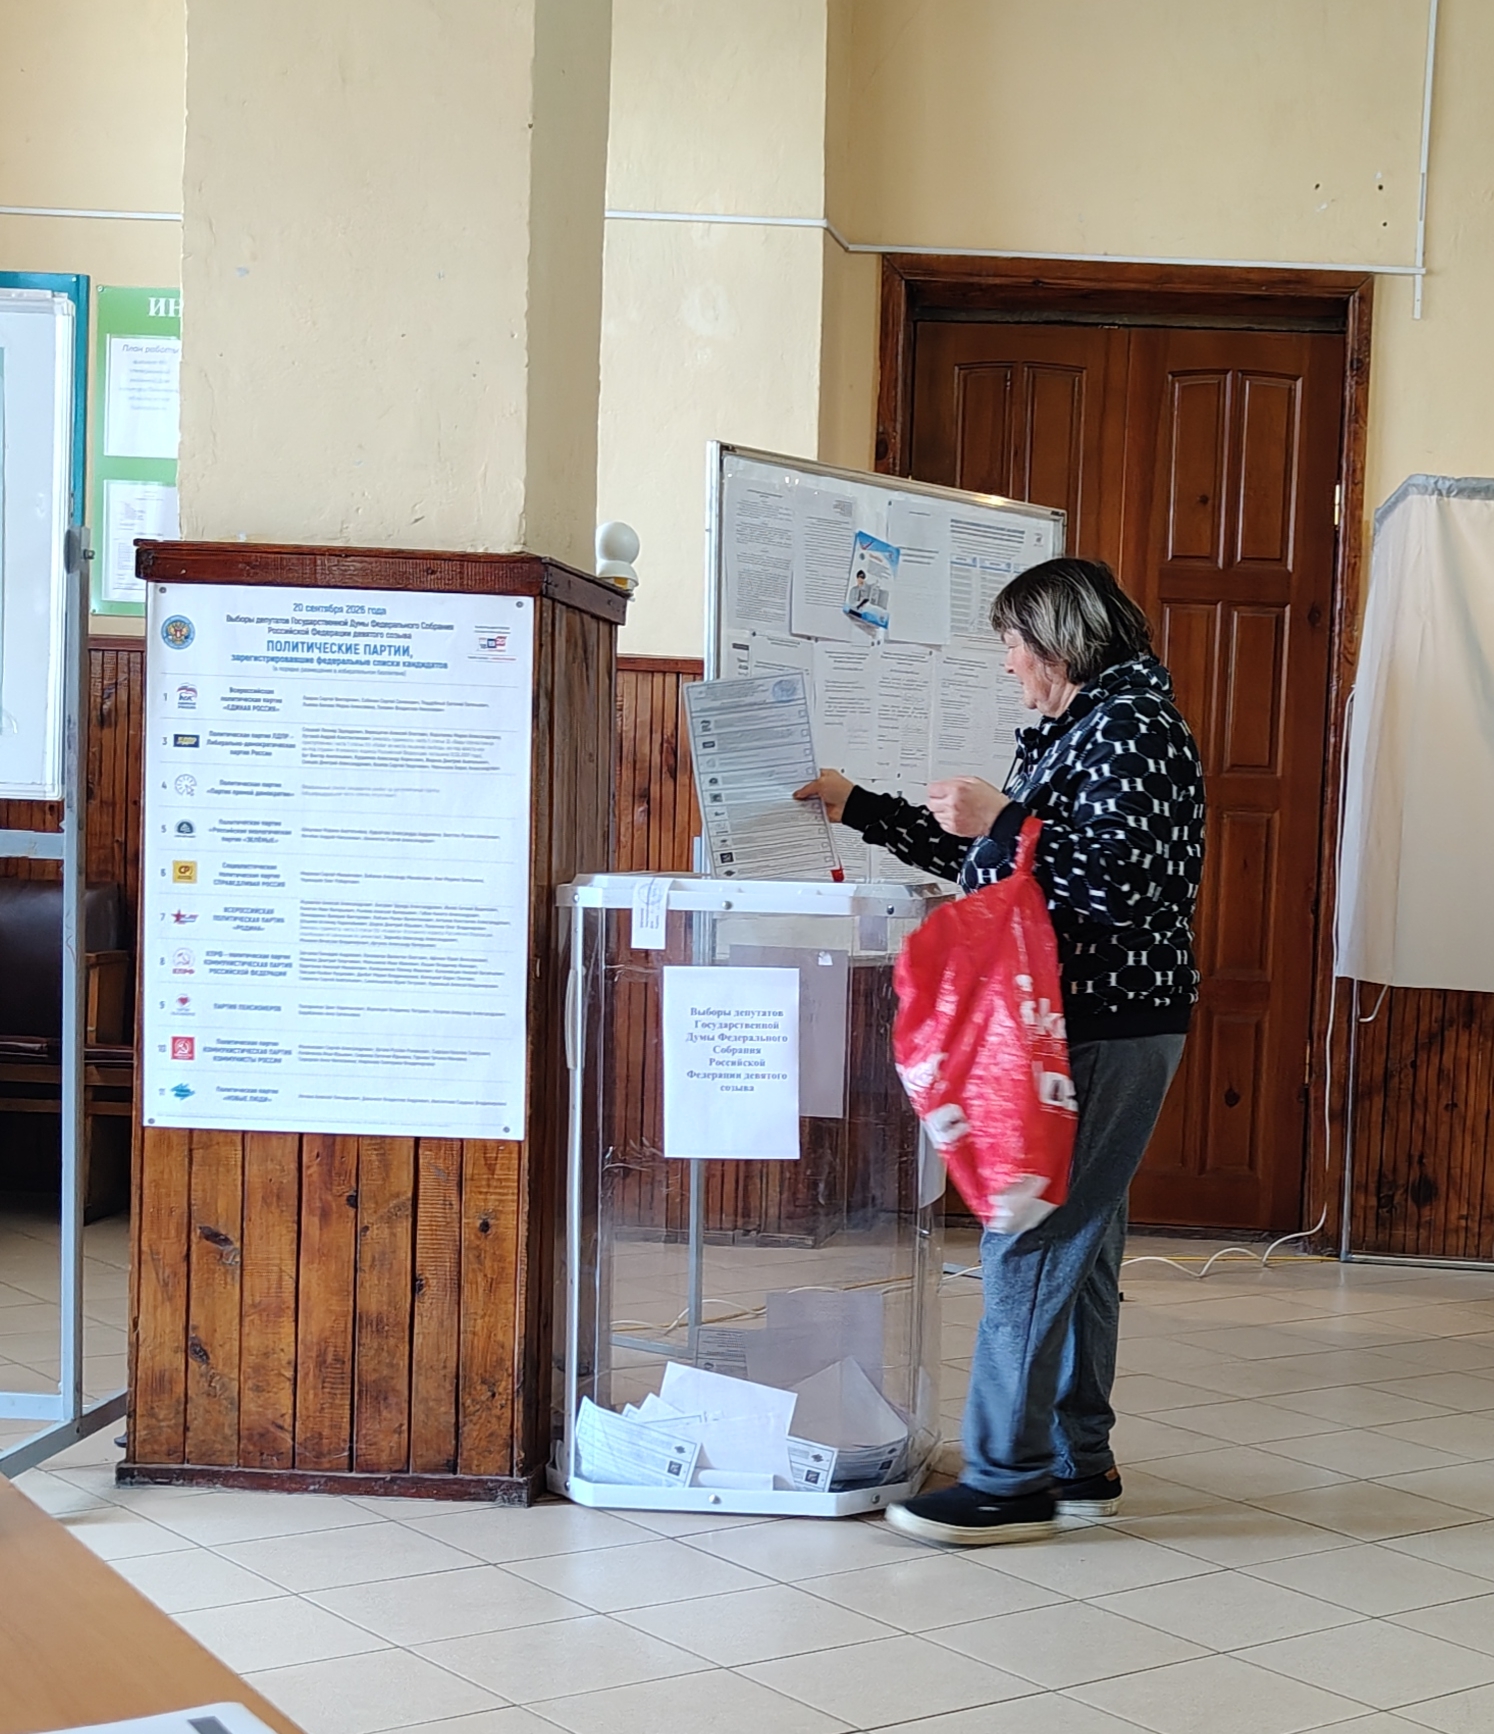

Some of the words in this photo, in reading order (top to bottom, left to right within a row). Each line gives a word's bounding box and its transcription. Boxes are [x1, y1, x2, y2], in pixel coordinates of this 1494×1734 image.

[122, 344, 143, 352] План
[293, 603, 303, 612] 20
[305, 604, 344, 614] сентября
[346, 605, 366, 614] 2026
[368, 607, 387, 615] года
[226, 614, 255, 624] Выборы
[256, 617, 290, 625] депутатов
[291, 616, 348, 627] Государственной
[349, 619, 370, 628] Думы
[371, 620, 420, 629] Федерального
[421, 621, 454, 631] Собрания
[268, 626, 309, 635] Российской
[311, 627, 351, 637] Федерации
[353, 631, 384, 639] девятого
[267, 640, 360, 655] ПОЛИТИЧЕСКИЕ
[364, 643, 413, 659] ПАРТИИ,
[231, 654, 314, 664] зарегистрировавшие
[316, 656, 370, 666] федеральные
[402, 661, 448, 669] кандидатов
[163, 693, 167, 701] 1
[162, 737, 167, 745] 3
[161, 781, 167, 789] 4
[161, 825, 167, 833] 5
[160, 912, 165, 921] 7
[690, 1007, 732, 1018] Выборы
[733, 1009, 784, 1019] депутатов
[694, 1020, 779, 1031] Государственной
[685, 1032, 715, 1043] Думы
[717, 1032, 788, 1044] Федерального
[712, 1045, 762, 1056] Собрания
[708, 1057, 766, 1067] Российской
[686, 1070, 742, 1081] Федерации
[743, 1071, 788, 1081] девятого
[720, 1084, 755, 1092] созыва
